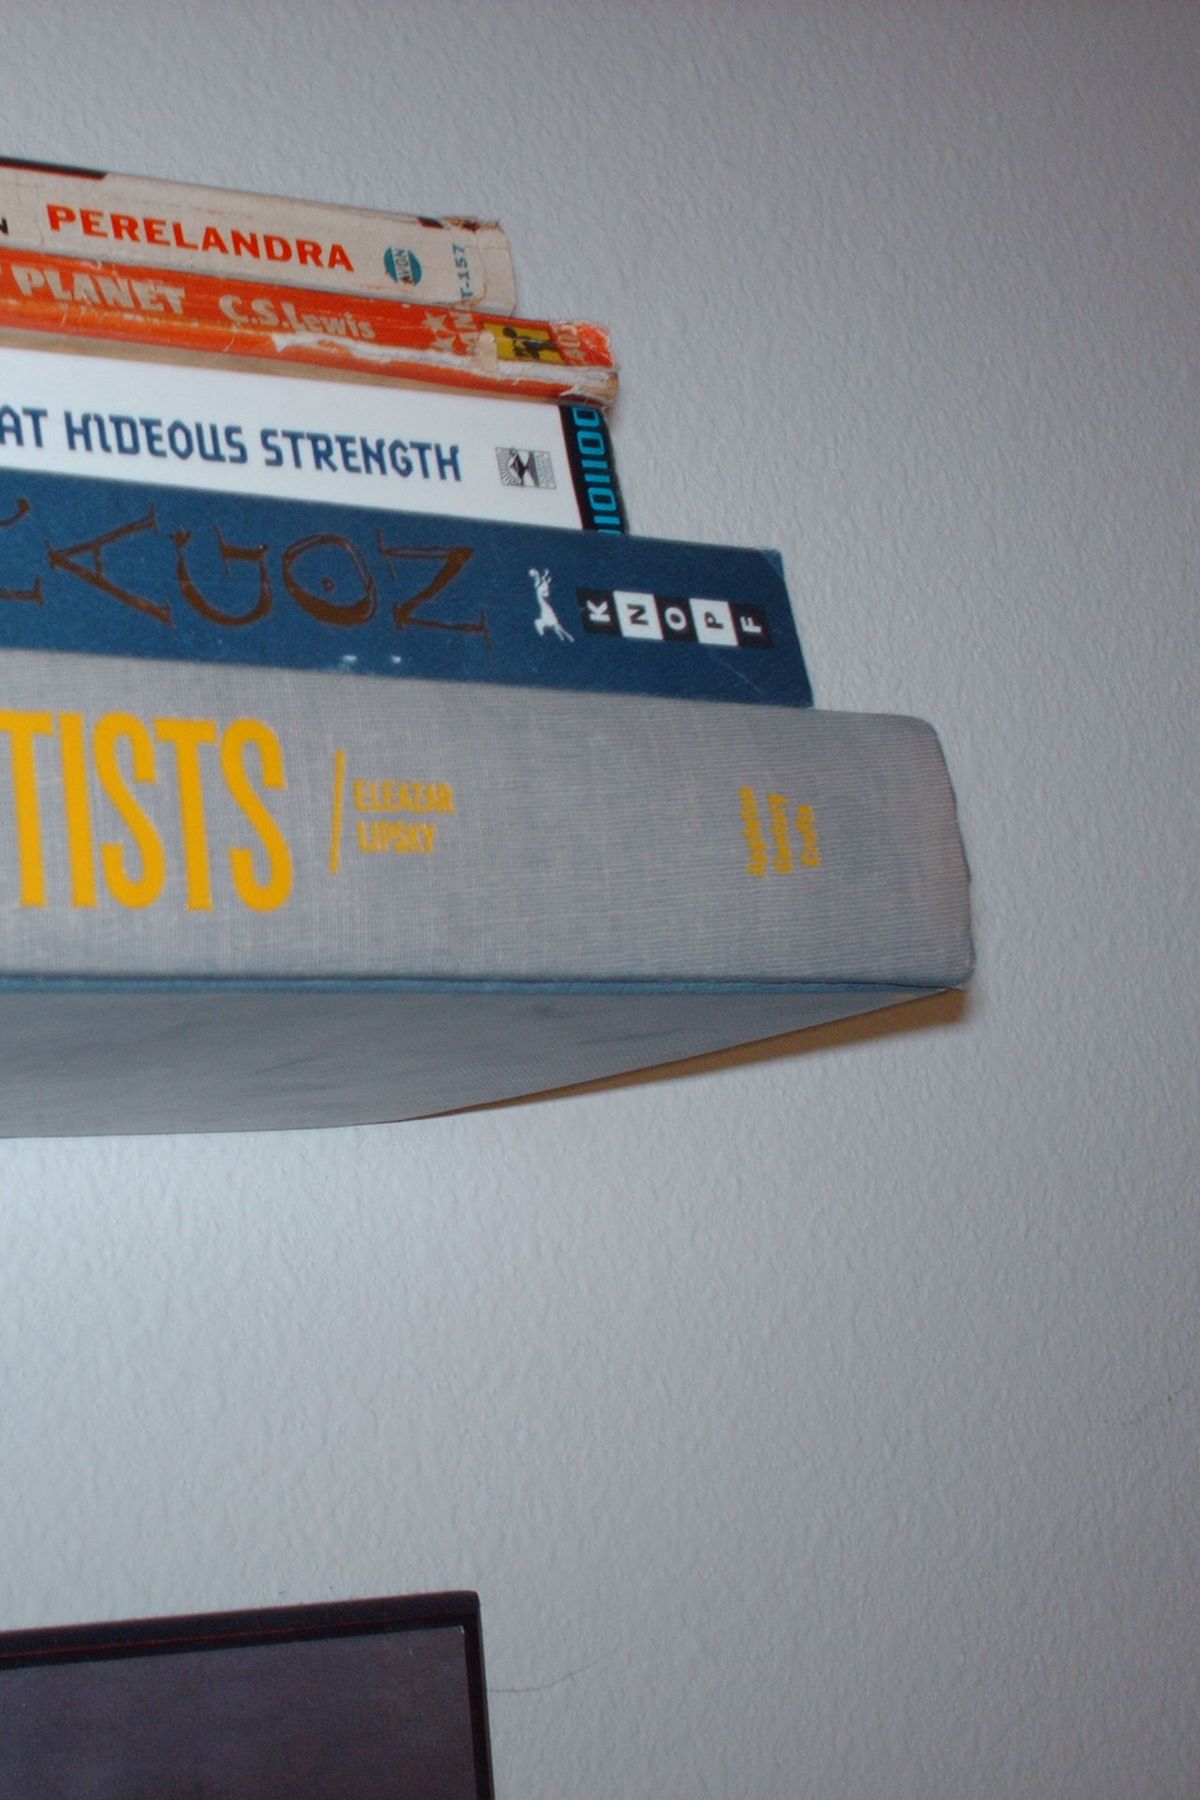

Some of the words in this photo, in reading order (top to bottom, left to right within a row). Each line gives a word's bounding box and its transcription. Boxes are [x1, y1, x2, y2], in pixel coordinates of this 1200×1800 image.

[46, 203, 355, 273] PERELANDRA
[11, 264, 185, 316] PLANET
[453, 243, 473, 299] T-157
[64, 413, 248, 466] HIDEOUS
[261, 431, 462, 484] STRENGTH
[586, 599, 762, 634] KNOPF
